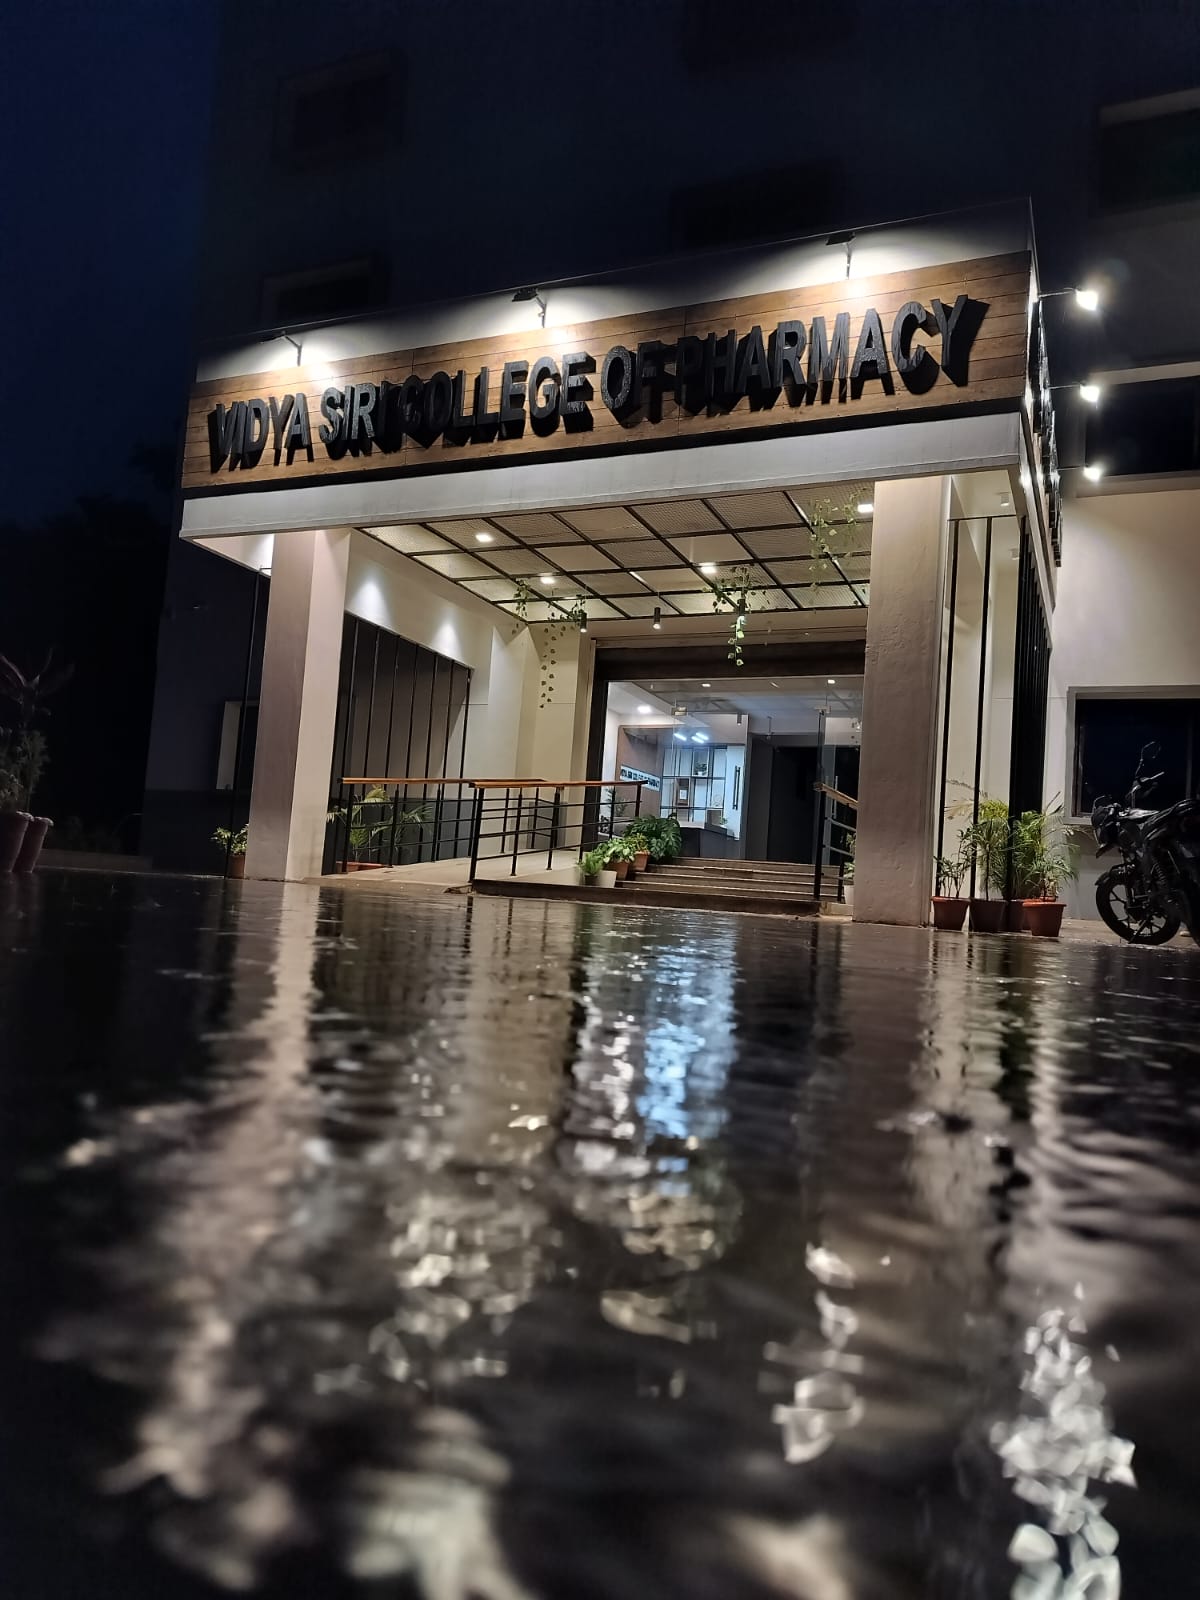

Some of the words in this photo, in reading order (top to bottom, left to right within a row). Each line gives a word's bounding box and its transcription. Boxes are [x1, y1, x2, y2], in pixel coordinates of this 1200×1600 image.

[212, 393, 312, 459] VIDYA
[319, 380, 394, 448] SIRI
[399, 352, 592, 434] COLLEGE
[601, 341, 664, 411] OF
[679, 295, 975, 404] PHARMACY
